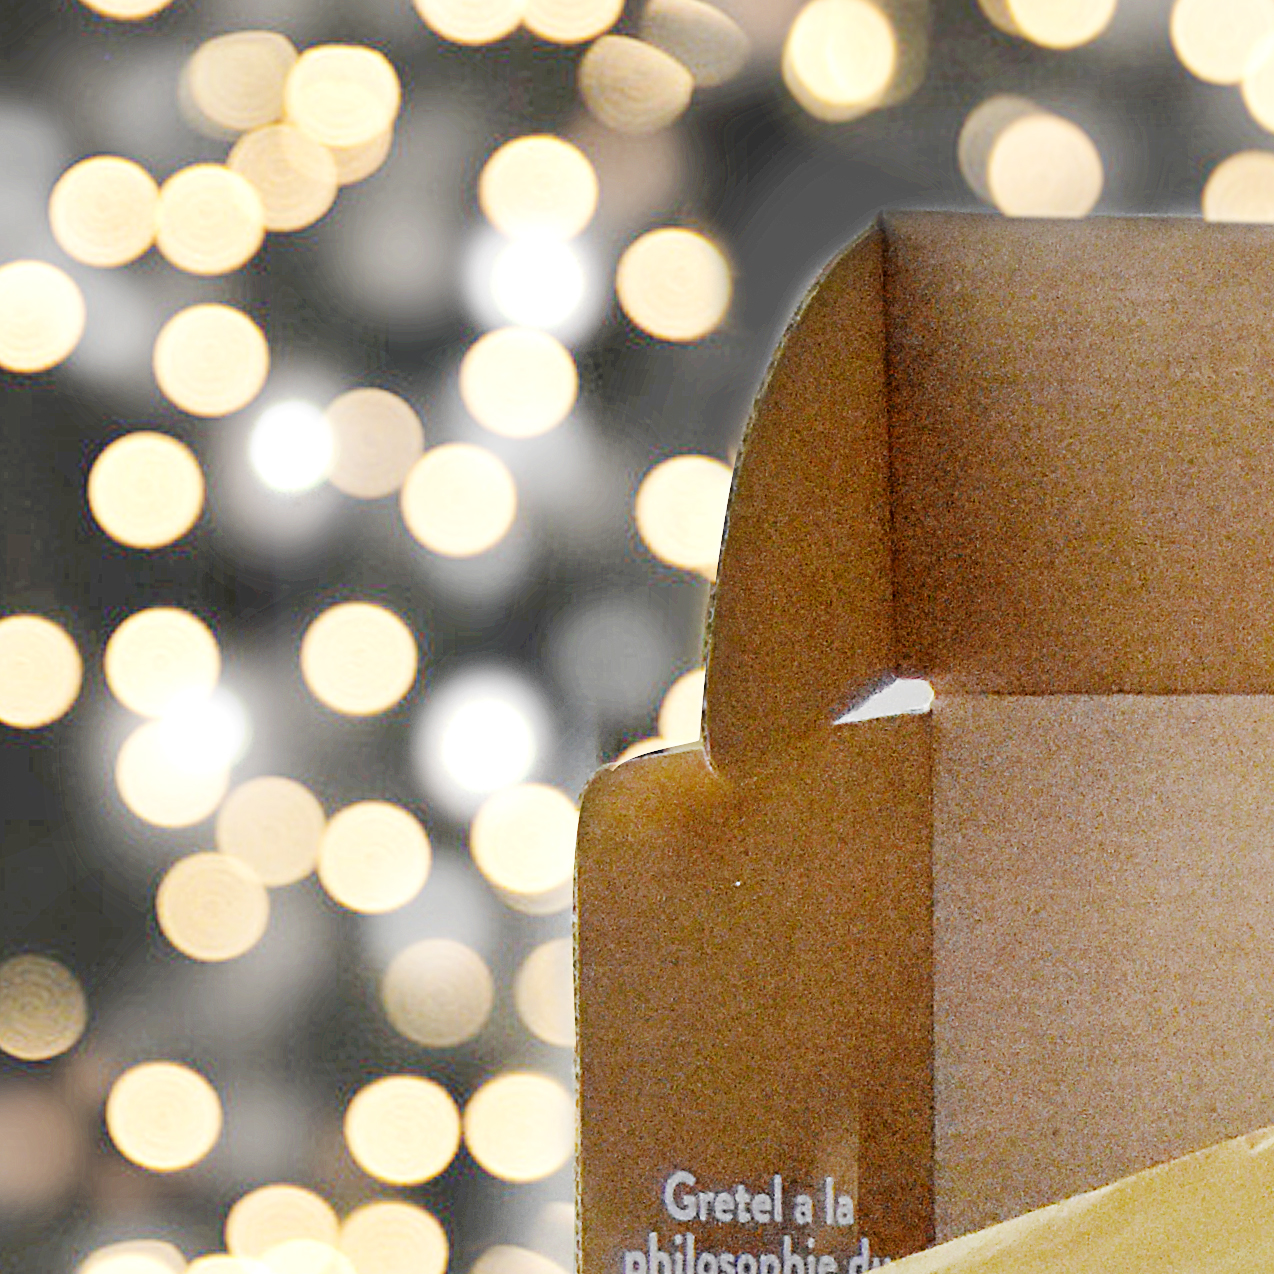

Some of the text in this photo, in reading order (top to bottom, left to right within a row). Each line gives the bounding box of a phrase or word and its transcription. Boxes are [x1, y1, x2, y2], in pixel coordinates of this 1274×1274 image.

[663, 1170, 855, 1226] Gretel a la
